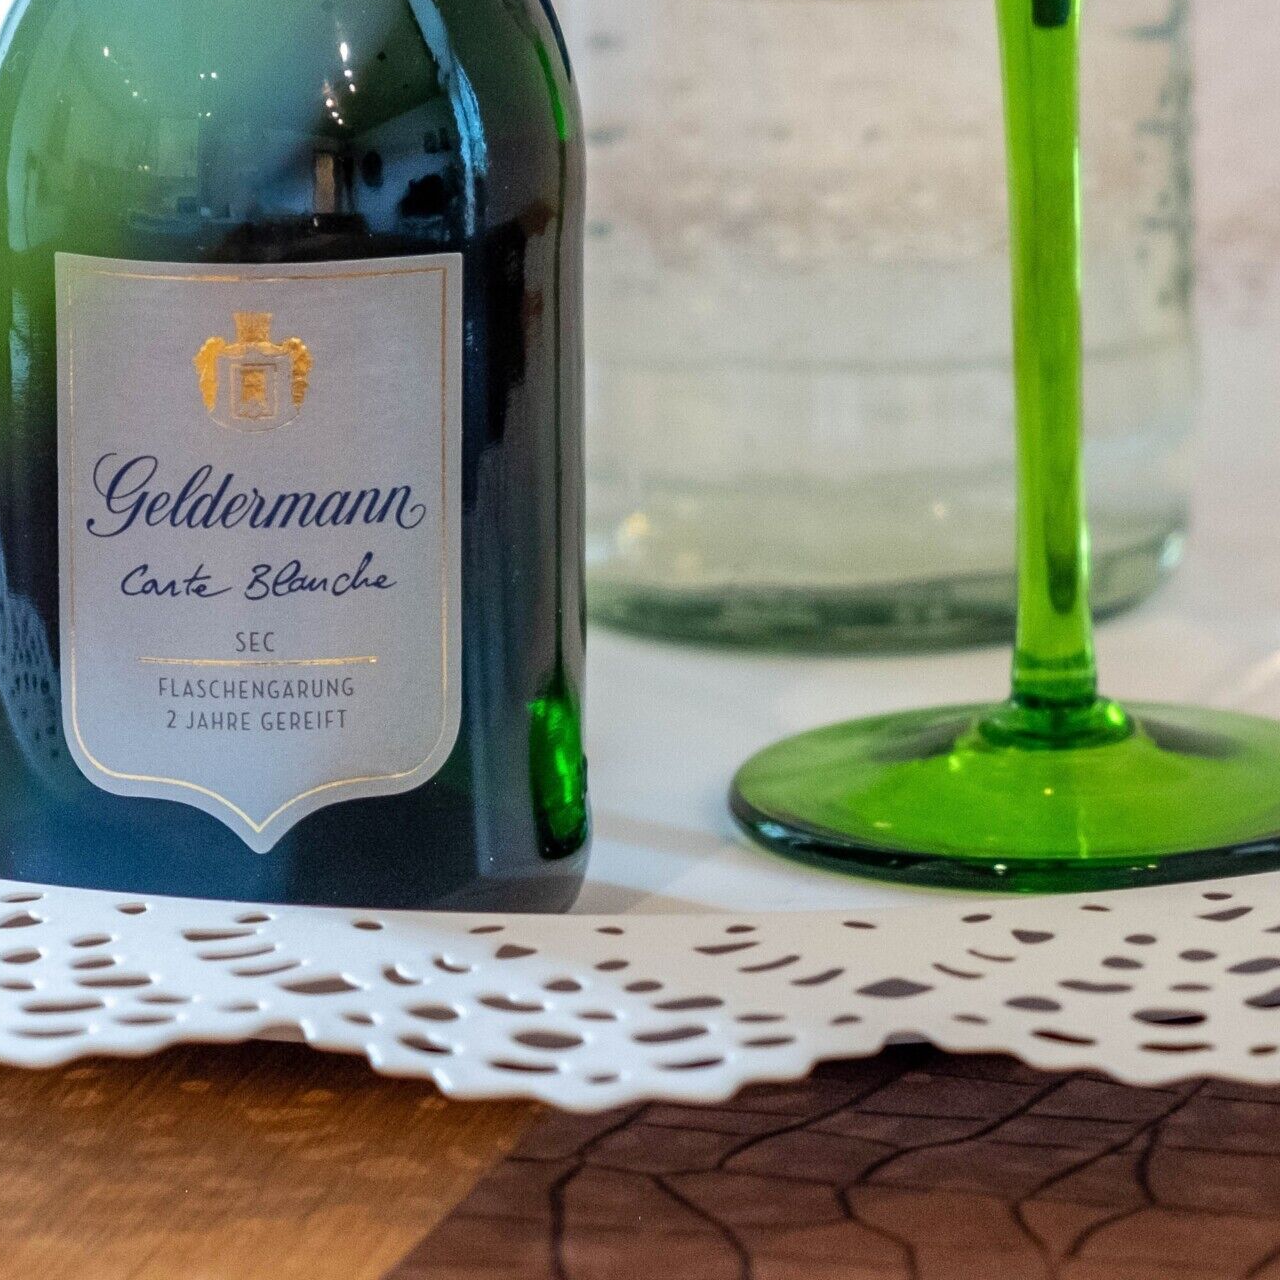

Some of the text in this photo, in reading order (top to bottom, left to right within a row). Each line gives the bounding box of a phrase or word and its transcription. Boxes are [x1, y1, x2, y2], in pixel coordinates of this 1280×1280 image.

[86, 452, 426, 537] Geldermann
[120, 551, 398, 601] Carte Blanche
[235, 631, 275, 653] SEC
[158, 676, 355, 699] FLASCHENGÄRUNG
[166, 709, 348, 731] 2 JAHRE GEREIFT
